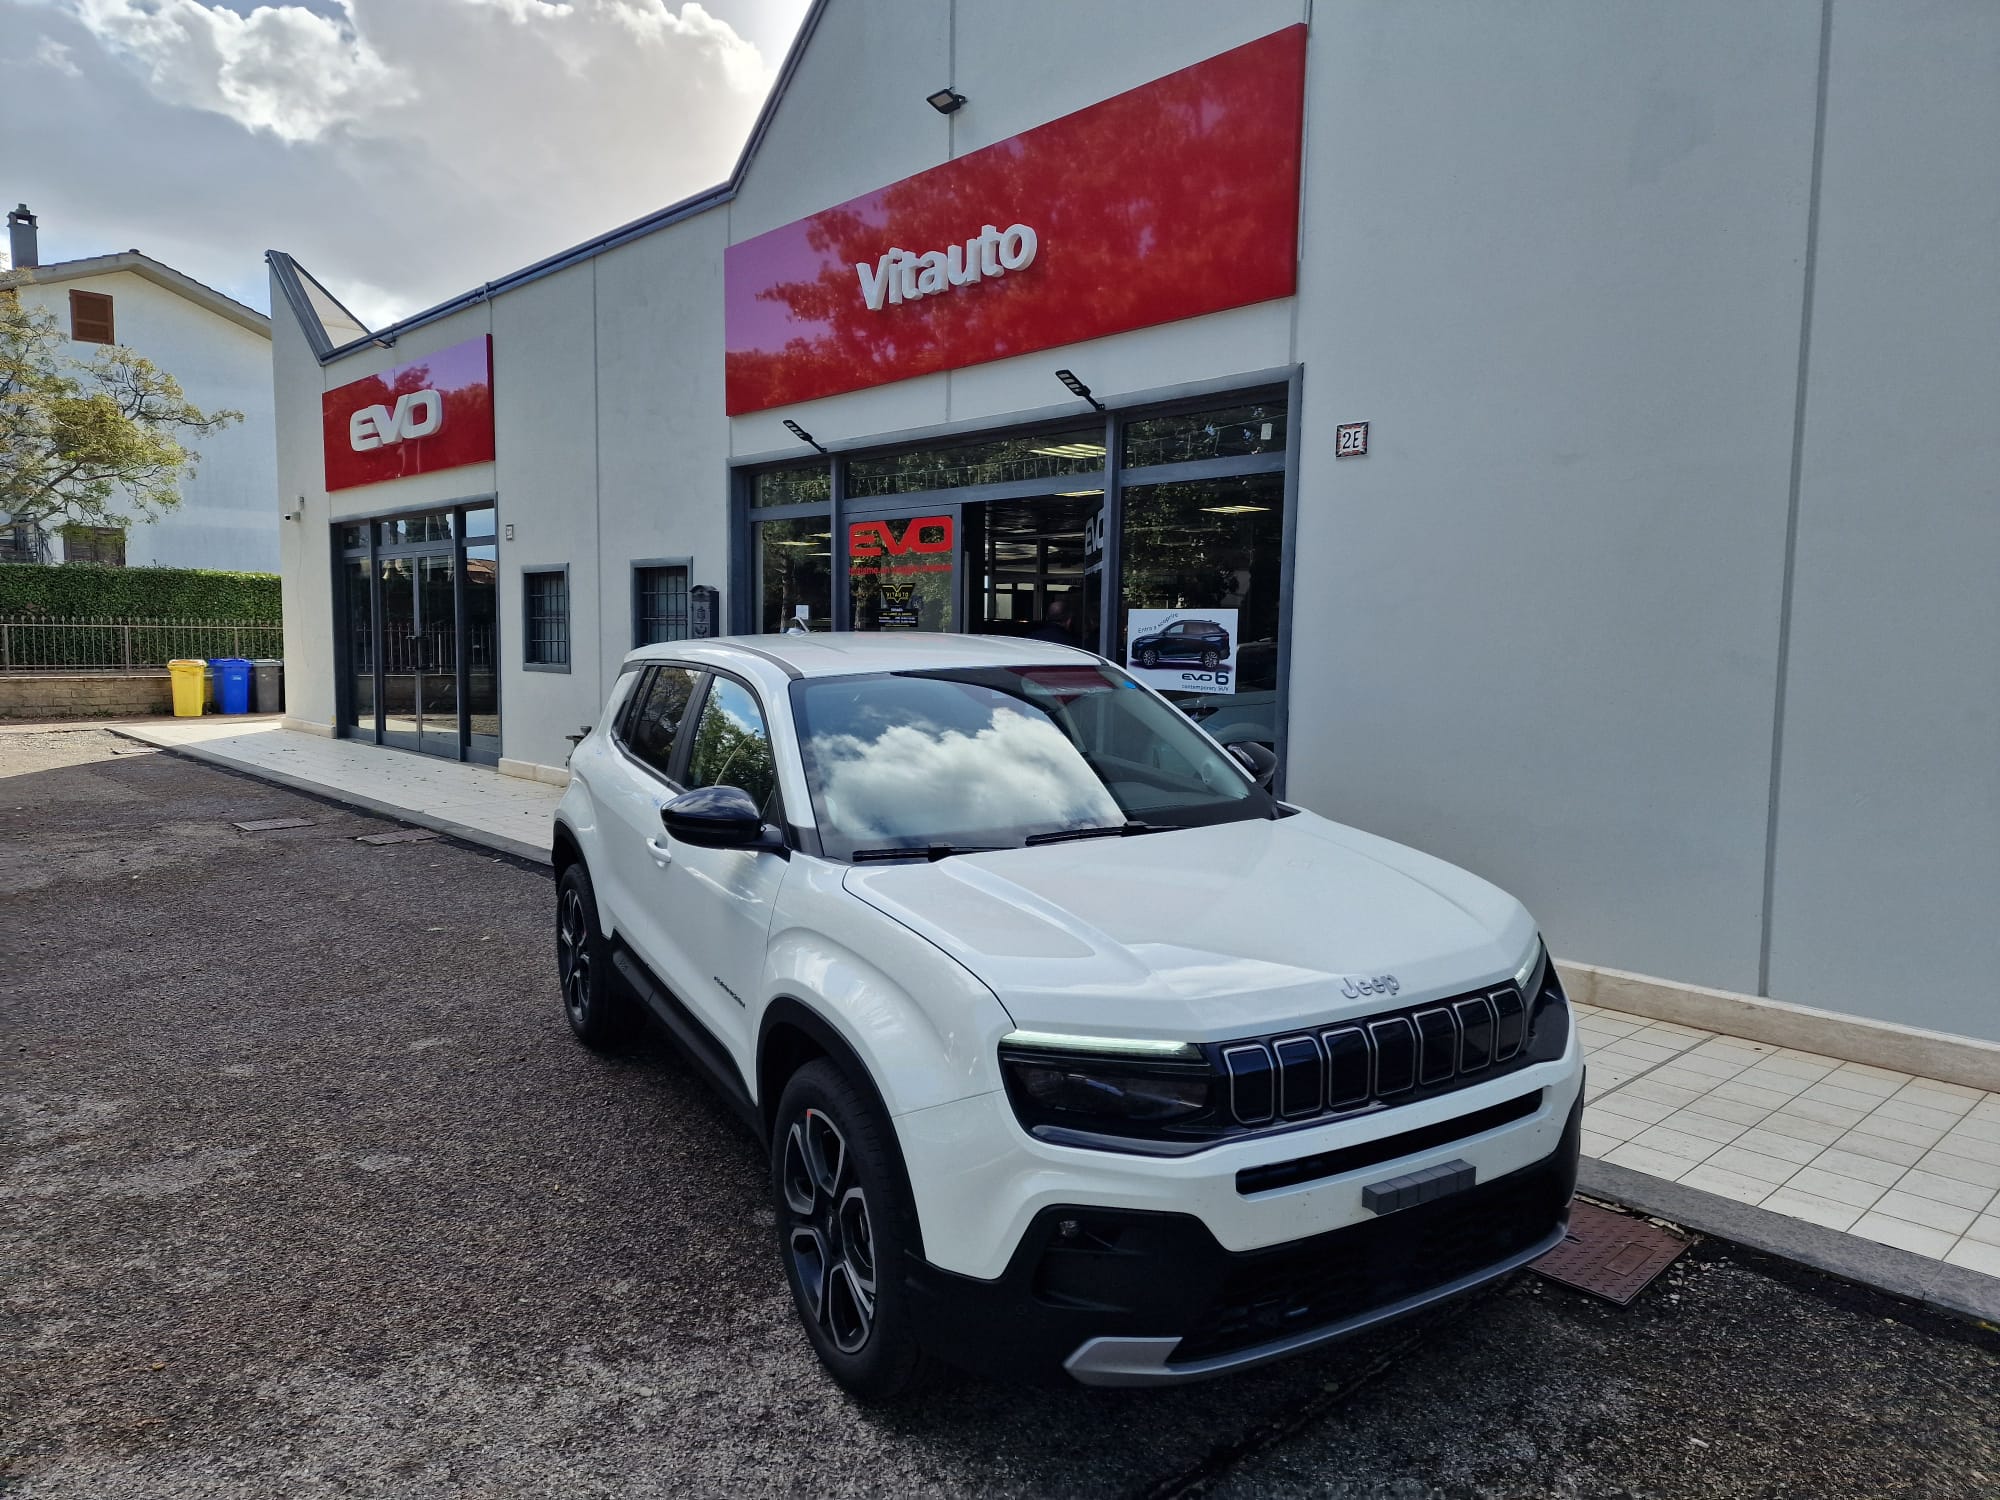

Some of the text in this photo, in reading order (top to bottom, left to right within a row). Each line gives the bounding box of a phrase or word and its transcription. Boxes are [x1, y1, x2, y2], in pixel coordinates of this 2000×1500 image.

[855, 223, 1038, 311] Vitauto
[349, 389, 443, 452] EVO
[1342, 430, 1361, 449] 2E
[849, 516, 953, 557] EVO
[1181, 670, 1229, 685] EVO 6
[1341, 975, 1400, 999] Jeep
